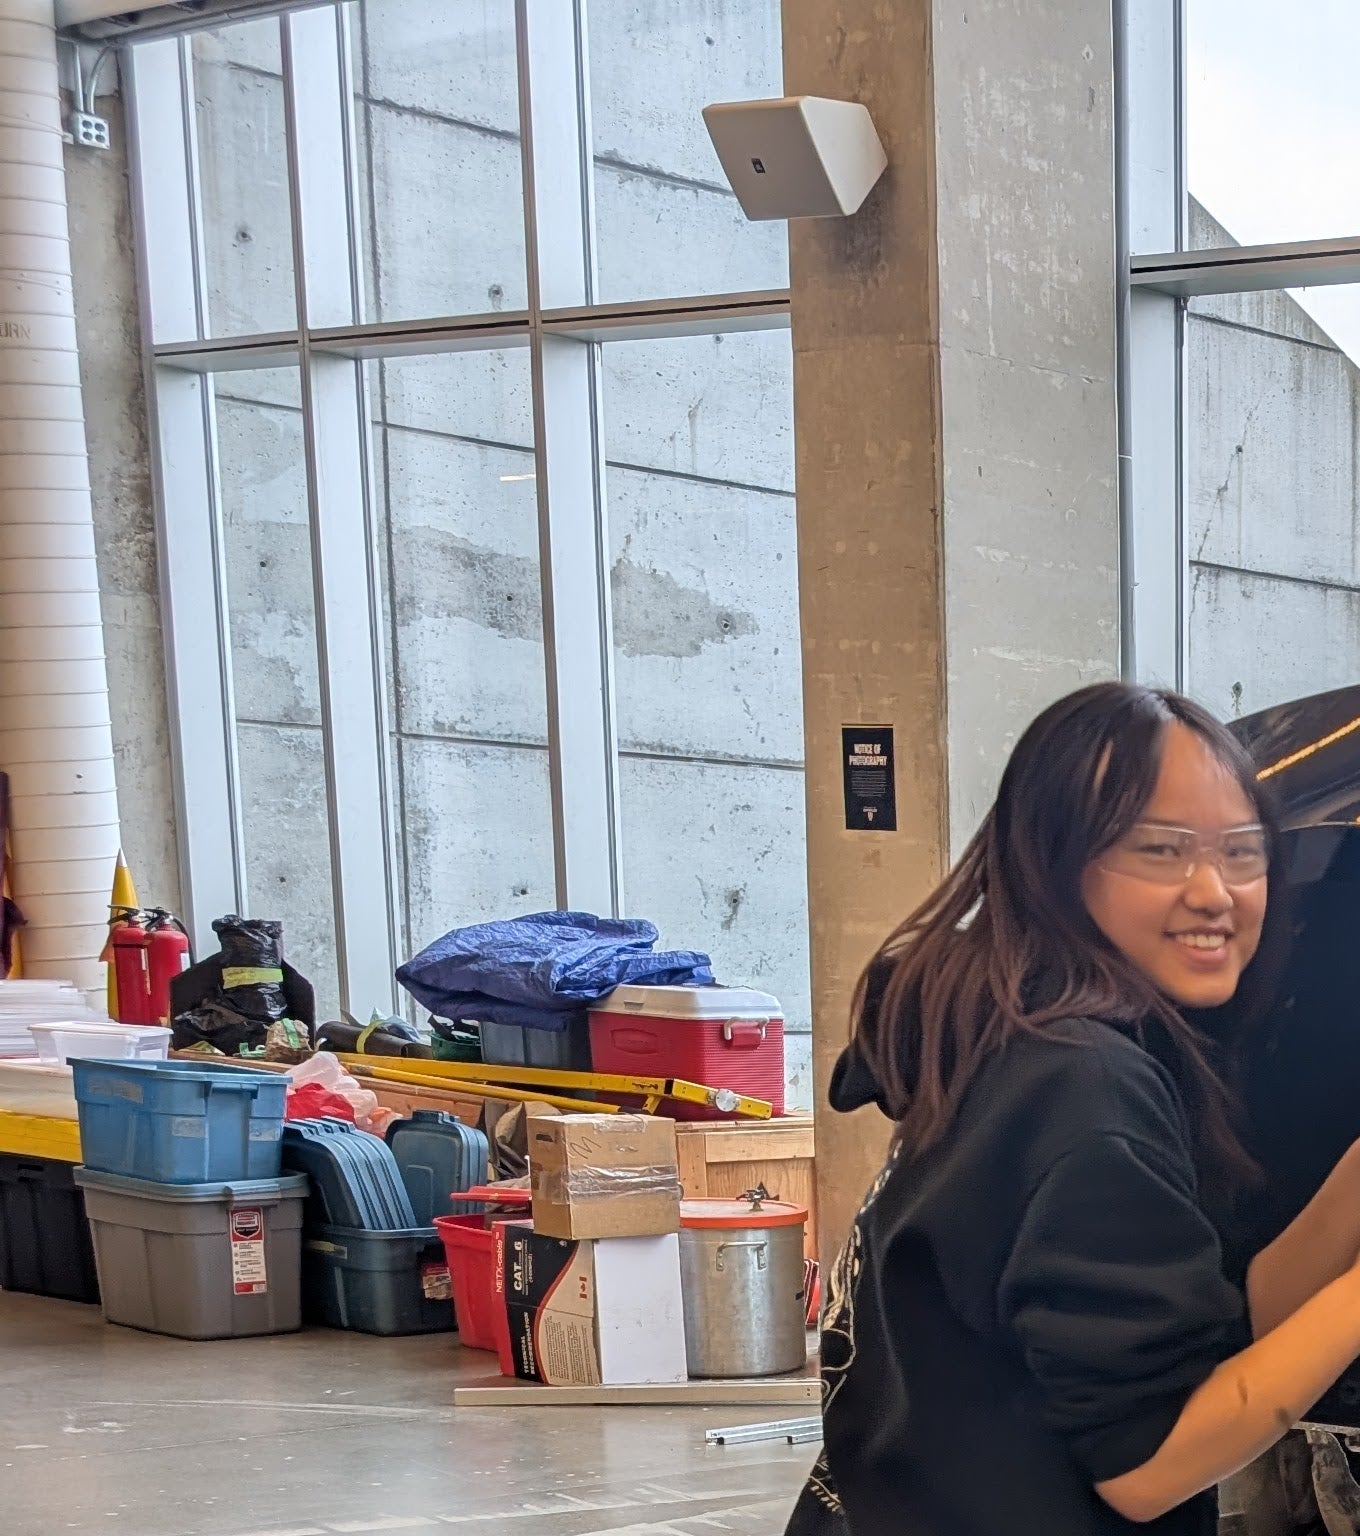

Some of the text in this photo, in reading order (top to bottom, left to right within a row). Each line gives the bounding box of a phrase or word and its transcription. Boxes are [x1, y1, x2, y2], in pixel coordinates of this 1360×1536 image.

[874, 744, 881, 754] OF
[849, 756, 887, 765] PHOTOGRAPHY
[514, 1241, 522, 1290] CAT 6
